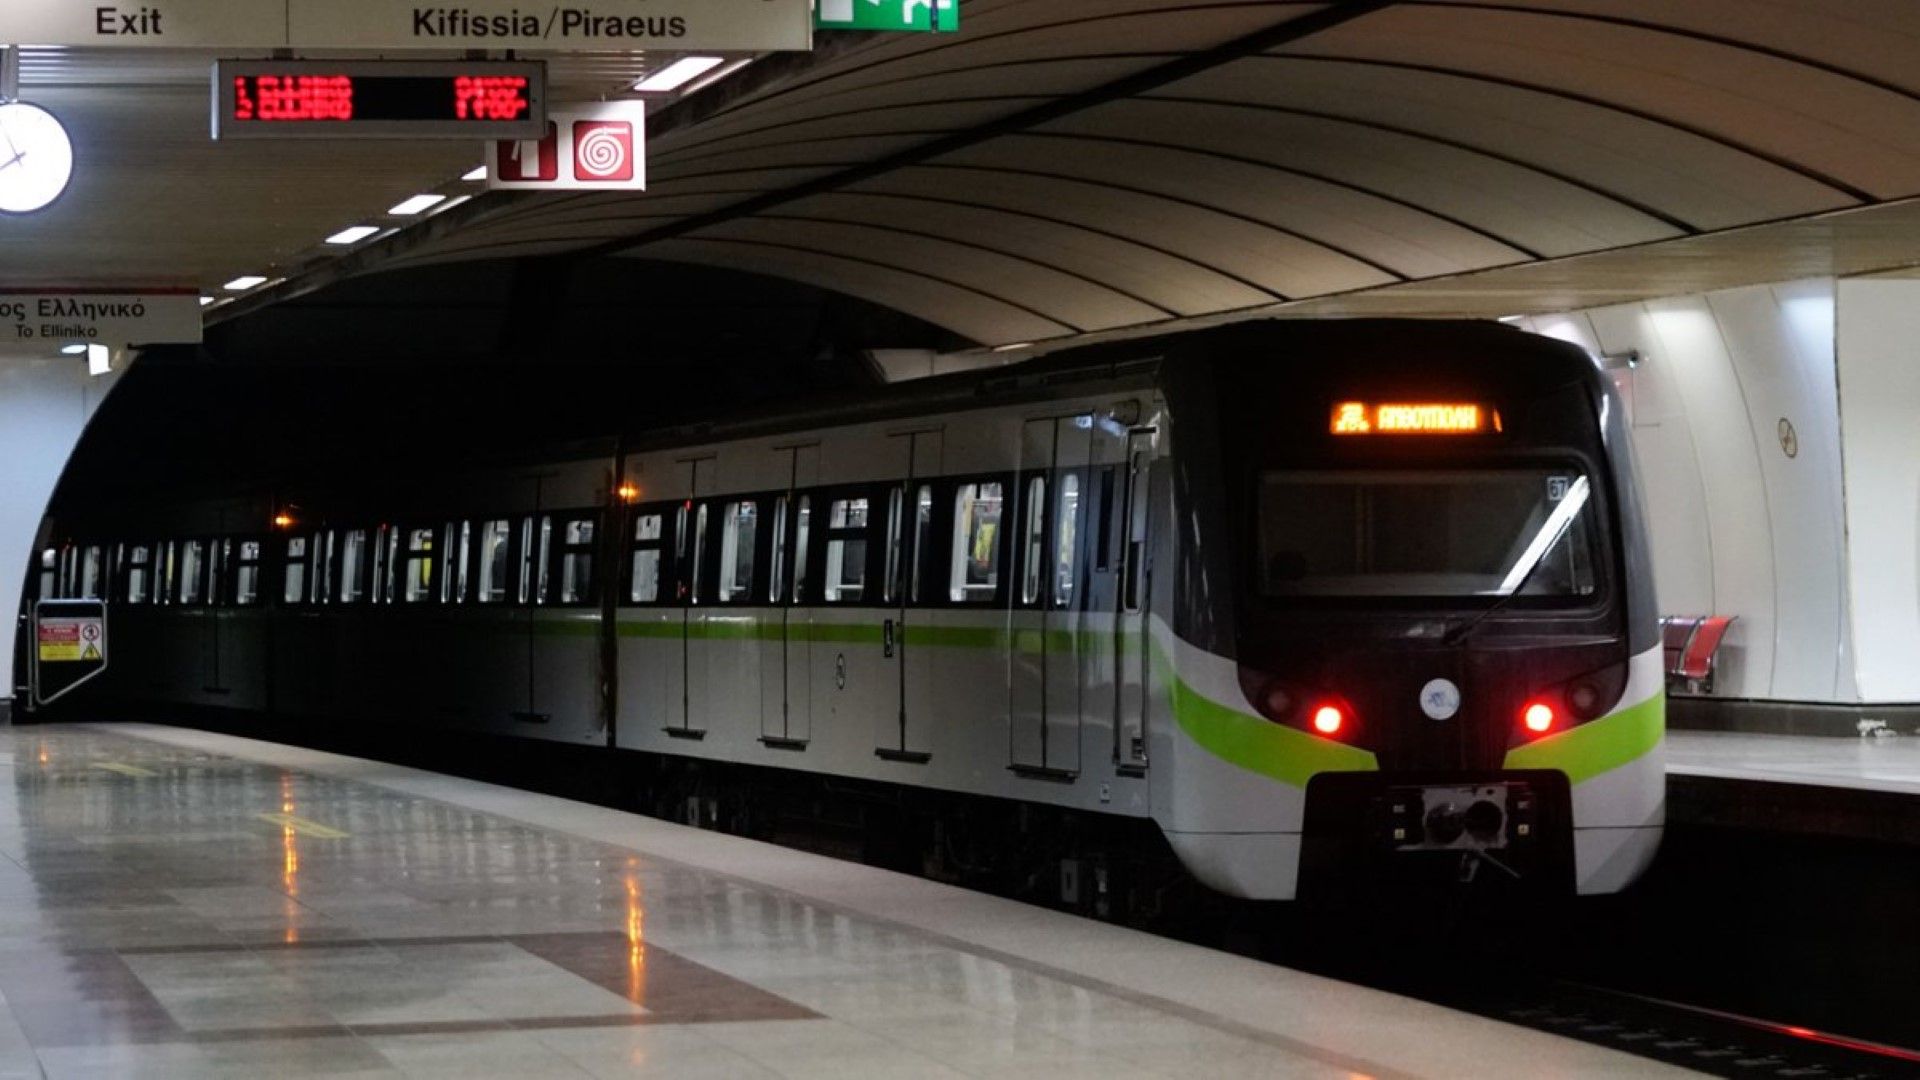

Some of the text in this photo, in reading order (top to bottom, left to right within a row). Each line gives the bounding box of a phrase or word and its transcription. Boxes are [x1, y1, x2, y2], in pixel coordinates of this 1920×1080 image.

[97, 8, 162, 34] Exit
[413, 7, 686, 38] Kifissia/Piraeus
[37, 298, 145, 321] Ελληνικό
[15, 324, 98, 338] To Elliniko
